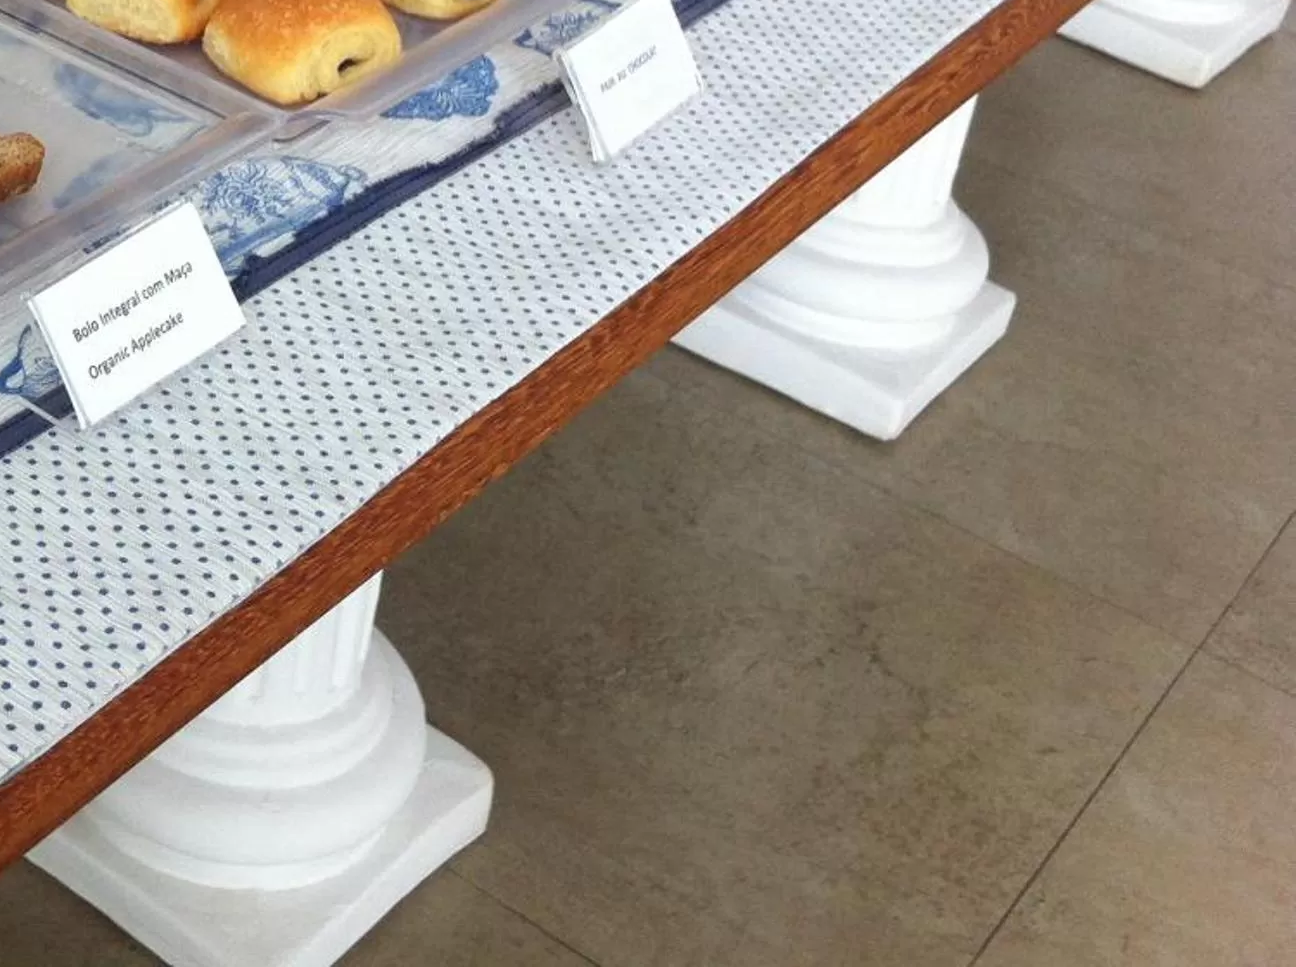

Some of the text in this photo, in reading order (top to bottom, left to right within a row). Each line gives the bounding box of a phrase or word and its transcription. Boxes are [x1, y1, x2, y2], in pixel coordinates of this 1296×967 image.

[72, 320, 100, 343] Bolo
[99, 290, 141, 327] Integral
[142, 279, 164, 300] com
[88, 312, 184, 379] Organic Applecake
